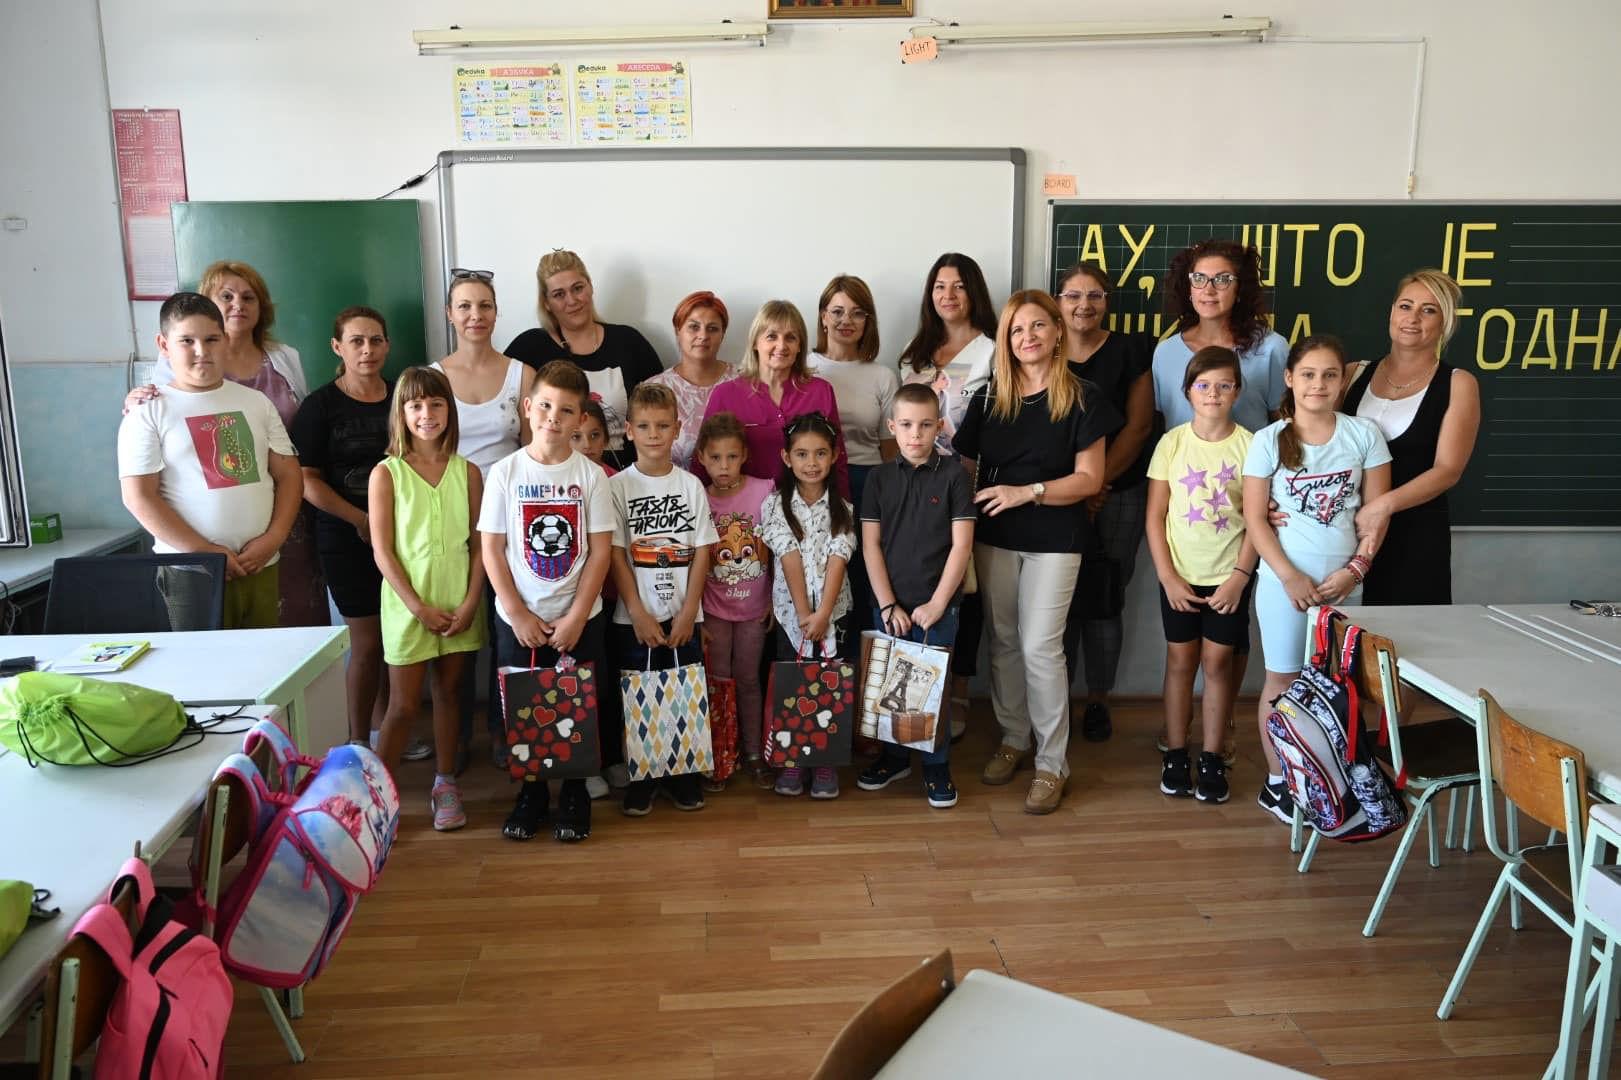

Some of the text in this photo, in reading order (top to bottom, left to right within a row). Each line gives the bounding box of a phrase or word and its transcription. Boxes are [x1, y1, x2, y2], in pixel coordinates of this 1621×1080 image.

[904, 41, 929, 56] LIGHT
[1044, 178, 1071, 189] BOARD
[518, 484, 545, 498] GAME
